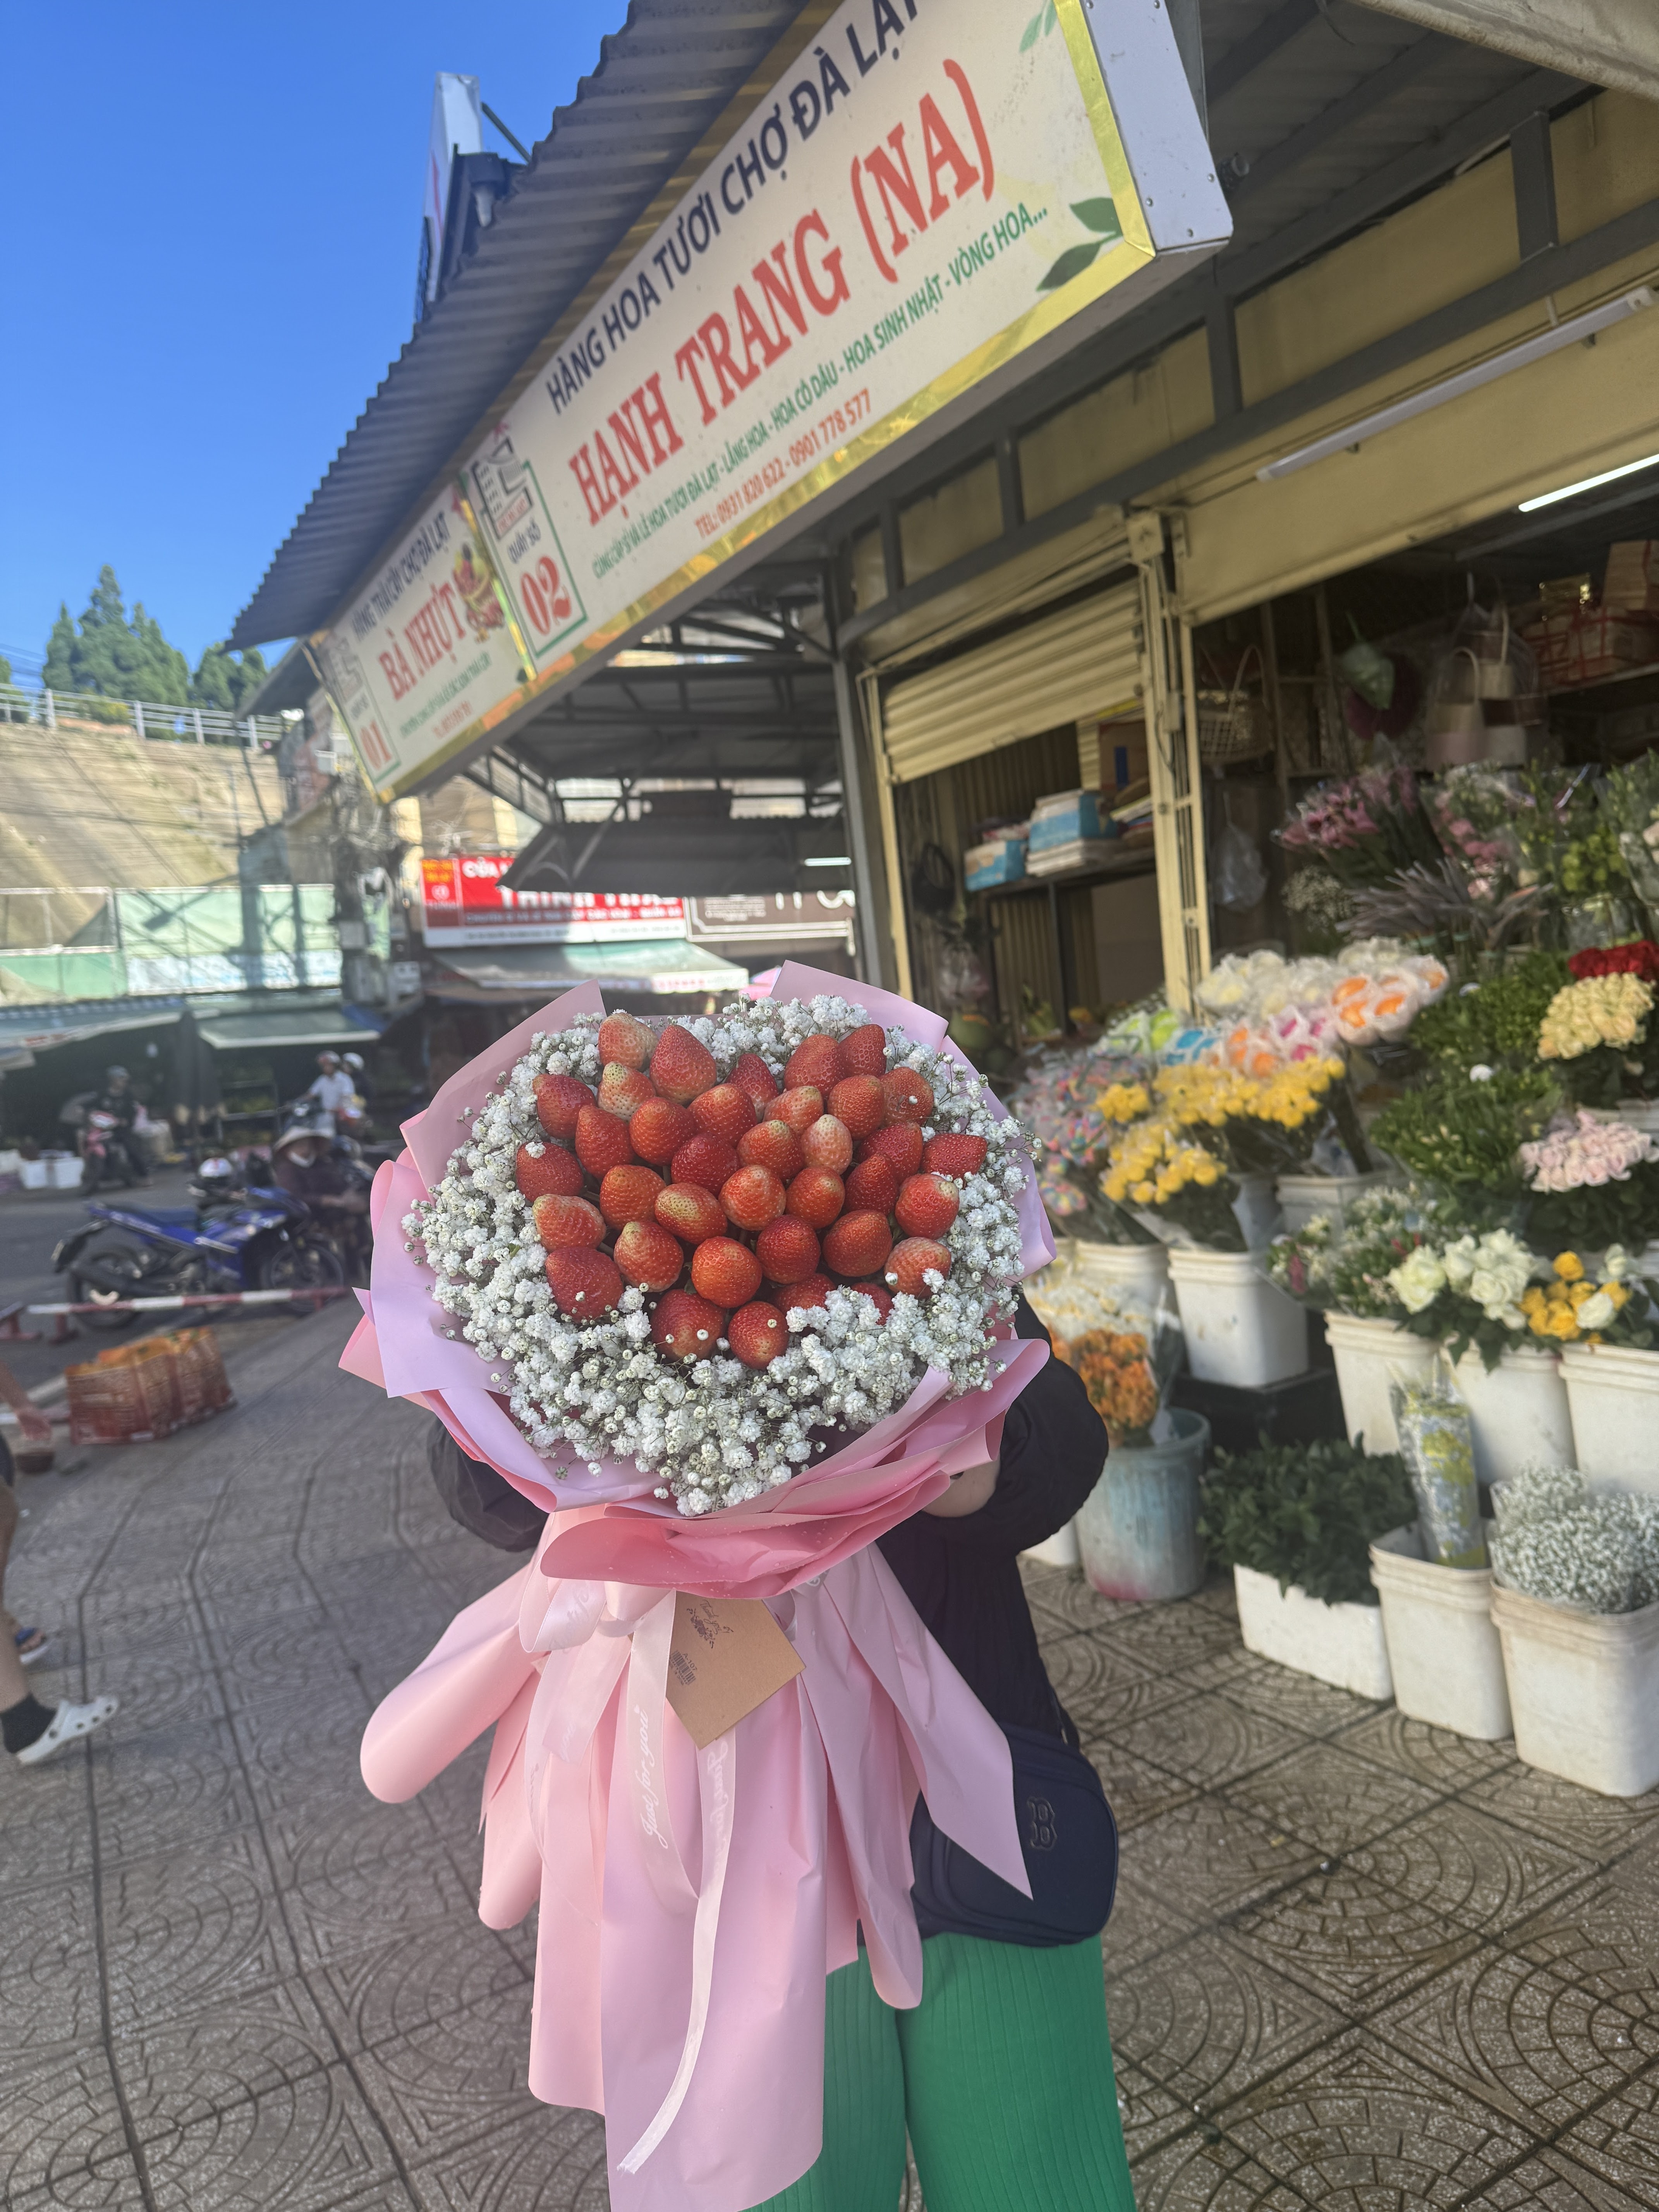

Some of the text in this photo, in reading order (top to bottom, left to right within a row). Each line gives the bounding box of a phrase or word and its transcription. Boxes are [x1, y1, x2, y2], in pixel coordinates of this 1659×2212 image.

[545, 327, 606, 415] HÀNG
[601, 271, 661, 352] HOA
[653, 191, 721, 290] TƯƠI
[720, 102, 788, 215] CHỢ
[788, 46, 851, 142] ĐÀ
[568, 58, 995, 527] HẠNH TRANG (NA)
[648, 503, 670, 531] HOA
[686, 471, 704, 503] ĐÀ
[699, 461, 720, 491] LẠT
[744, 421, 771, 455] HOA
[770, 396, 799, 432] HOA
[794, 378, 813, 411] CÔ
[809, 360, 839, 399] DÂU
[842, 332, 876, 373] HOA
[872, 304, 909, 350] SINH
[905, 273, 944, 325] NHẬT
[948, 231, 995, 287] VÒNG
[761, 455, 786, 489] 622
[789, 428, 821, 467] 0901
[817, 409, 847, 445] 778
[843, 387, 871, 426] 577
[520, 555, 572, 636] 02
[378, 627, 417, 701] BÀ
[360, 719, 392, 771] 01
[700, 1599, 722, 1635] Thank you
[682, 1653, 697, 1671] A-107
[635, 1709, 668, 1849] Just for you
[1026, 1796, 1058, 1851] B
